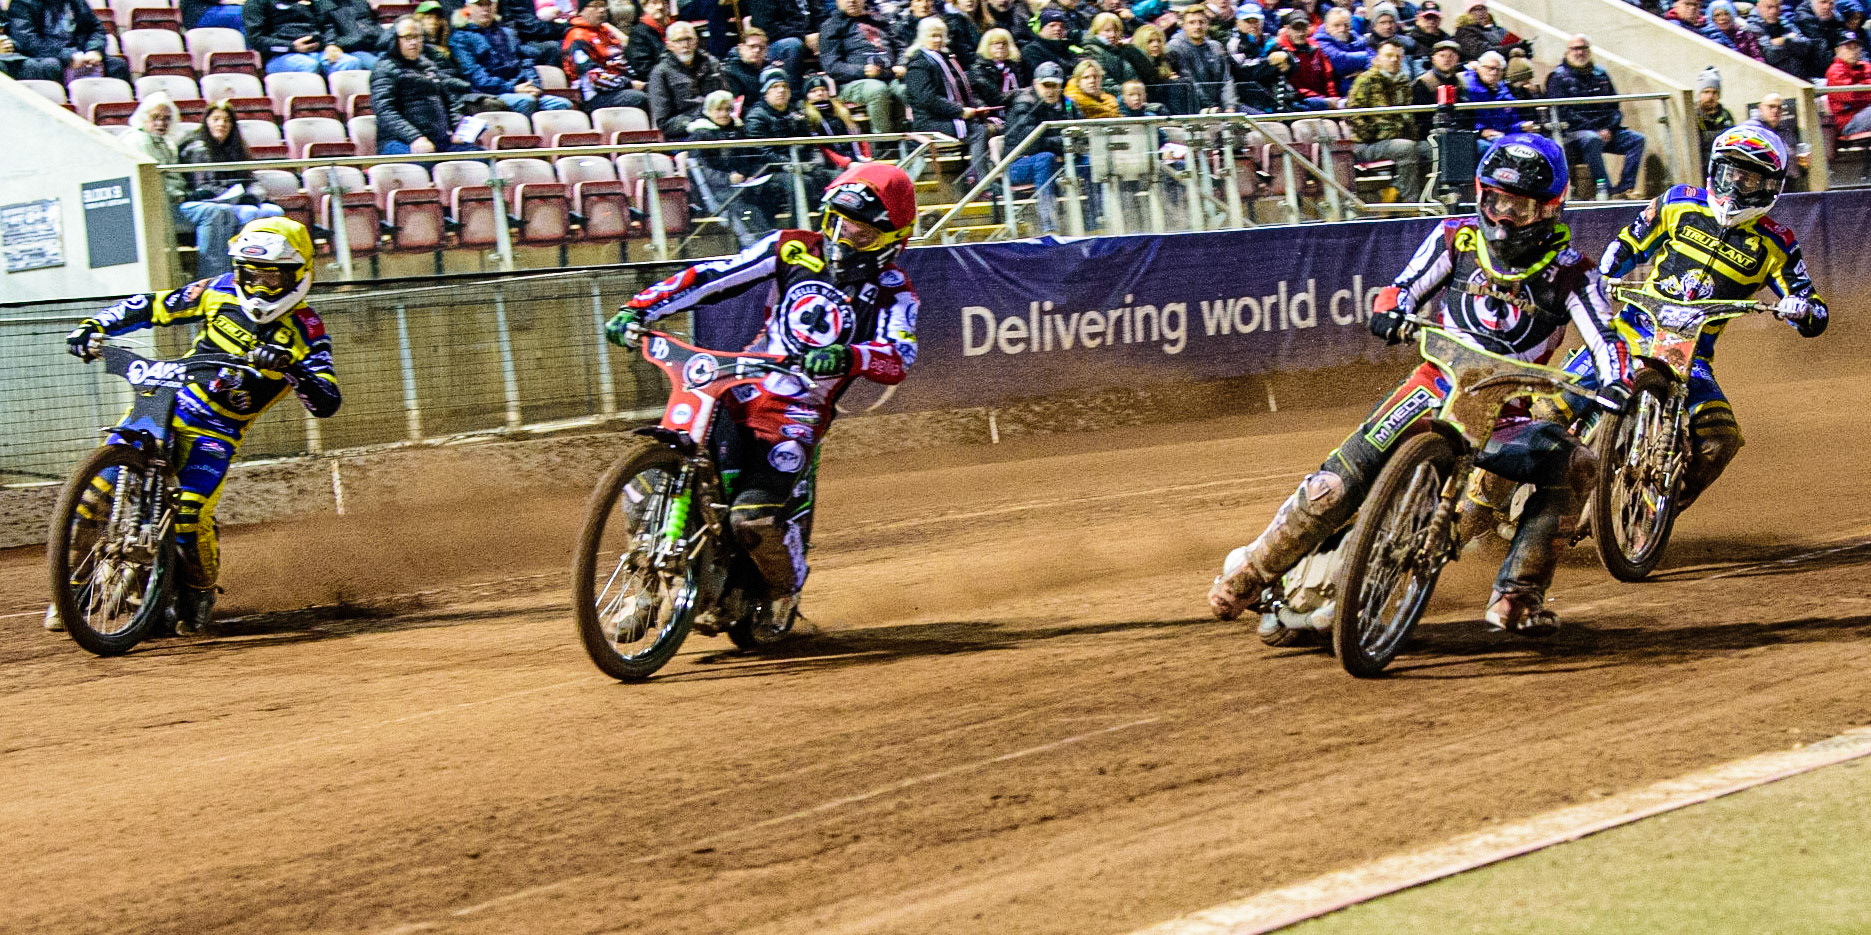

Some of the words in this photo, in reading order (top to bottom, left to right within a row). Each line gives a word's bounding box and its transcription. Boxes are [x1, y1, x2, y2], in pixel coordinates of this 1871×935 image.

[1743, 235, 1761, 252] 4
[863, 285, 877, 304] 4
[961, 294, 1187, 356] Delivering
[1201, 278, 1318, 337] world
